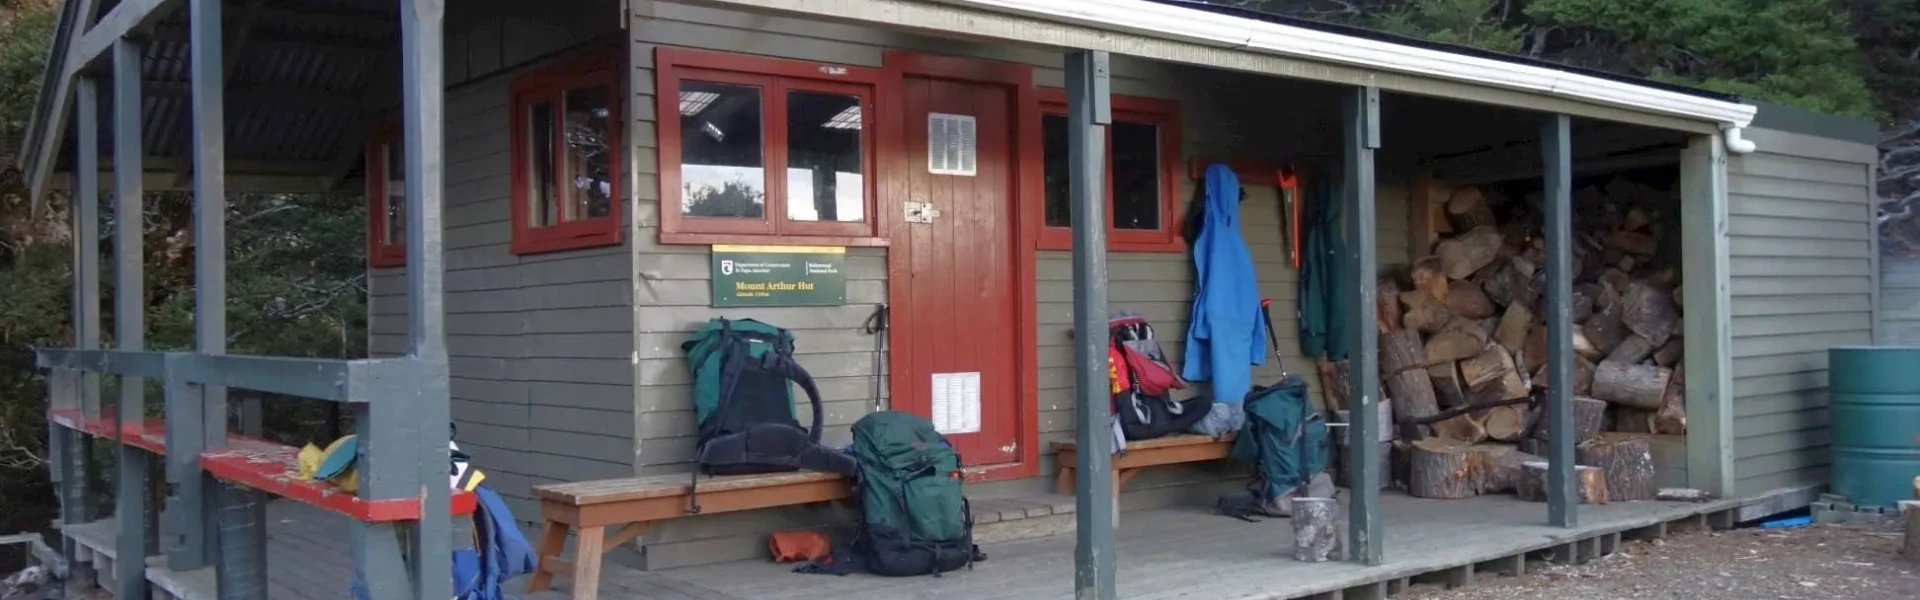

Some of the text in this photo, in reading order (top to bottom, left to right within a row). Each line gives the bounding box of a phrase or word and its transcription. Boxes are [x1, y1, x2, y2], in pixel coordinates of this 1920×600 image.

[735, 281, 815, 290] Mount Arthur Hut
